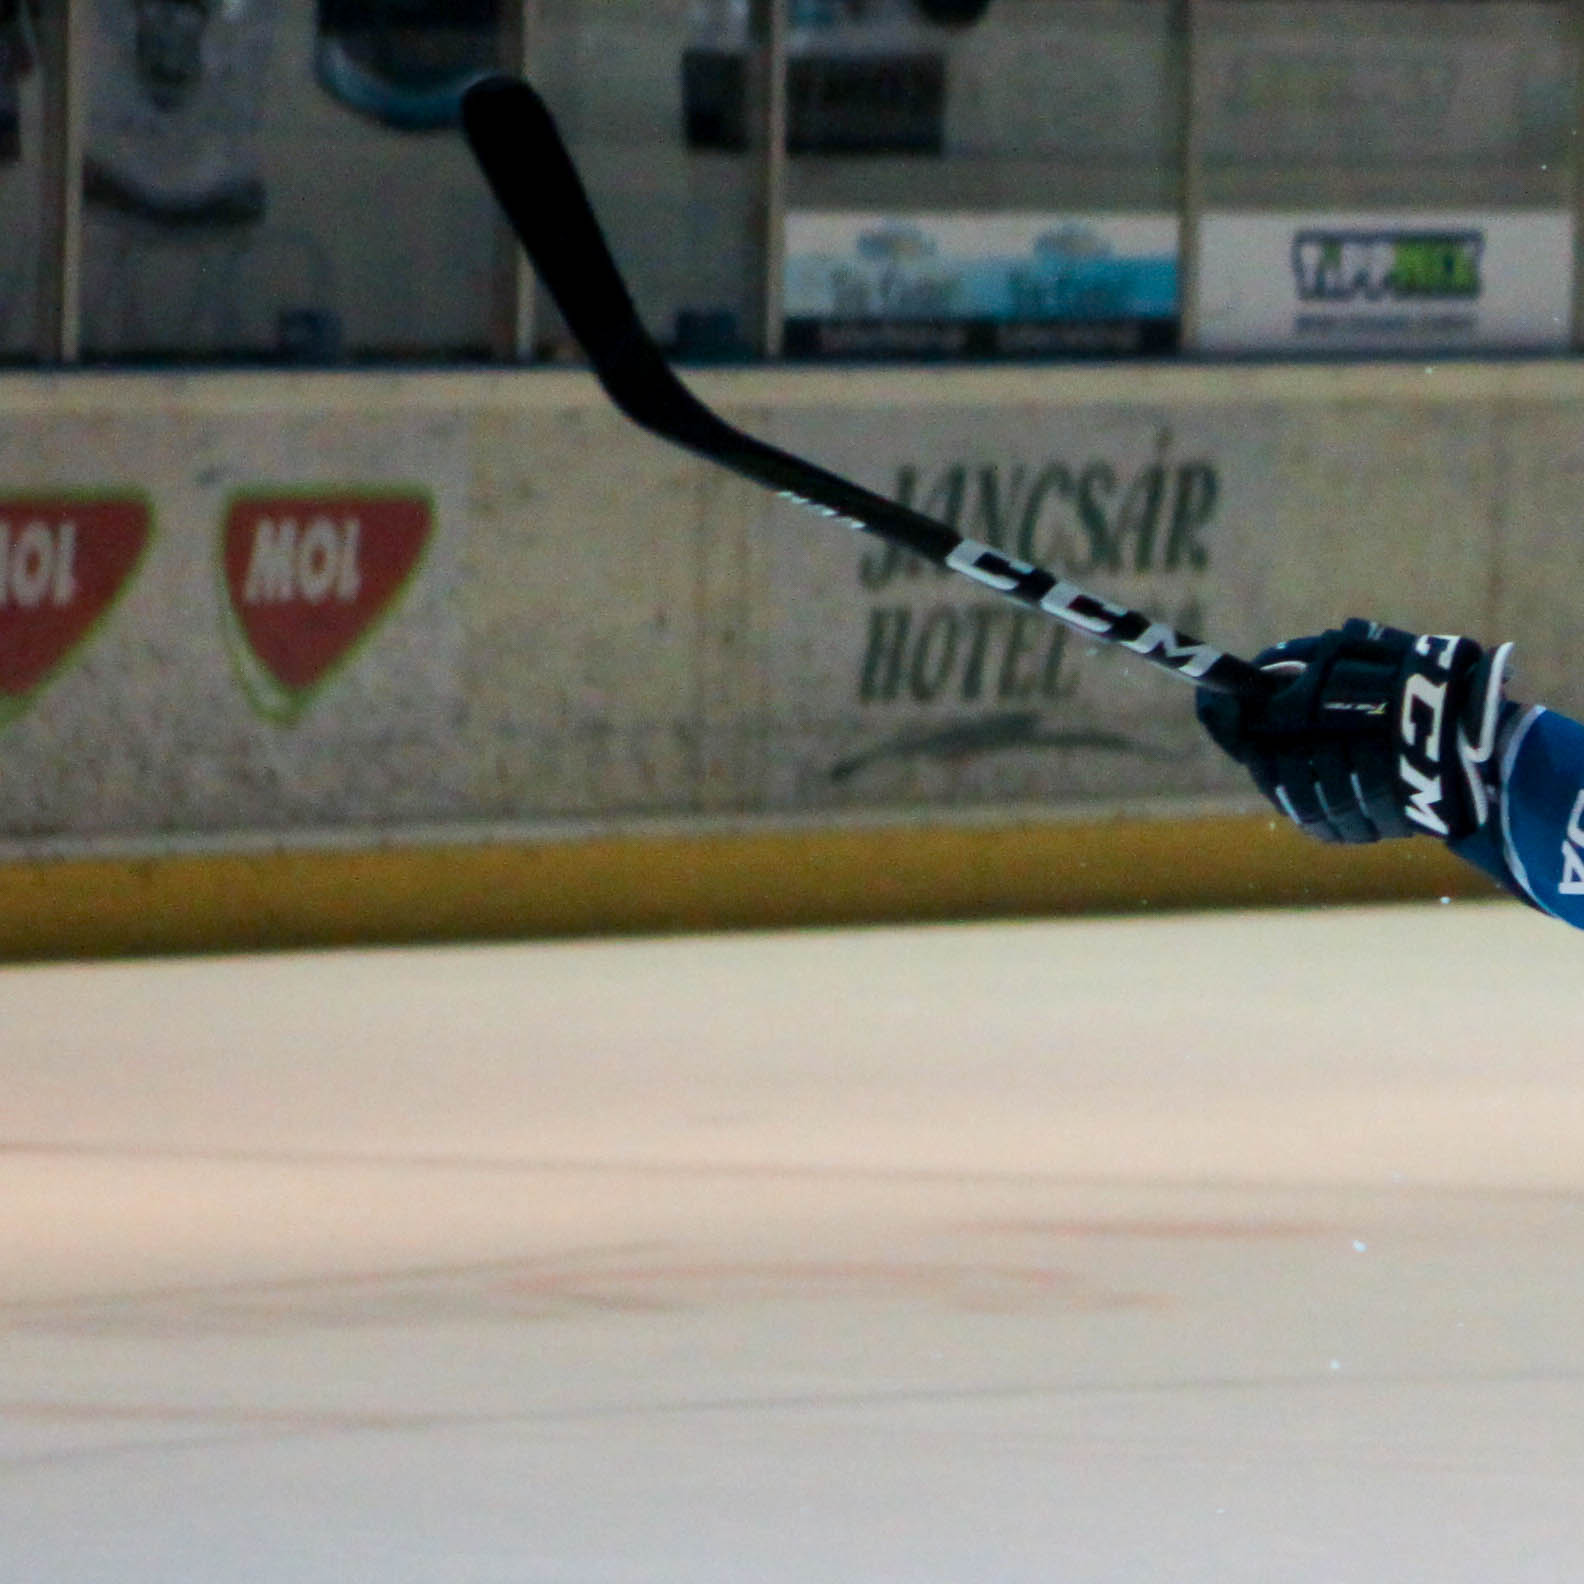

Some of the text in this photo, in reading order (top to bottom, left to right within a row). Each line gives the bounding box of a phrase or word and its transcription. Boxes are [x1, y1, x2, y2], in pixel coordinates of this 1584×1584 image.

[243, 517, 362, 606] MOL
[945, 537, 1223, 681] CCM
[857, 603, 1081, 705] HOTEL
